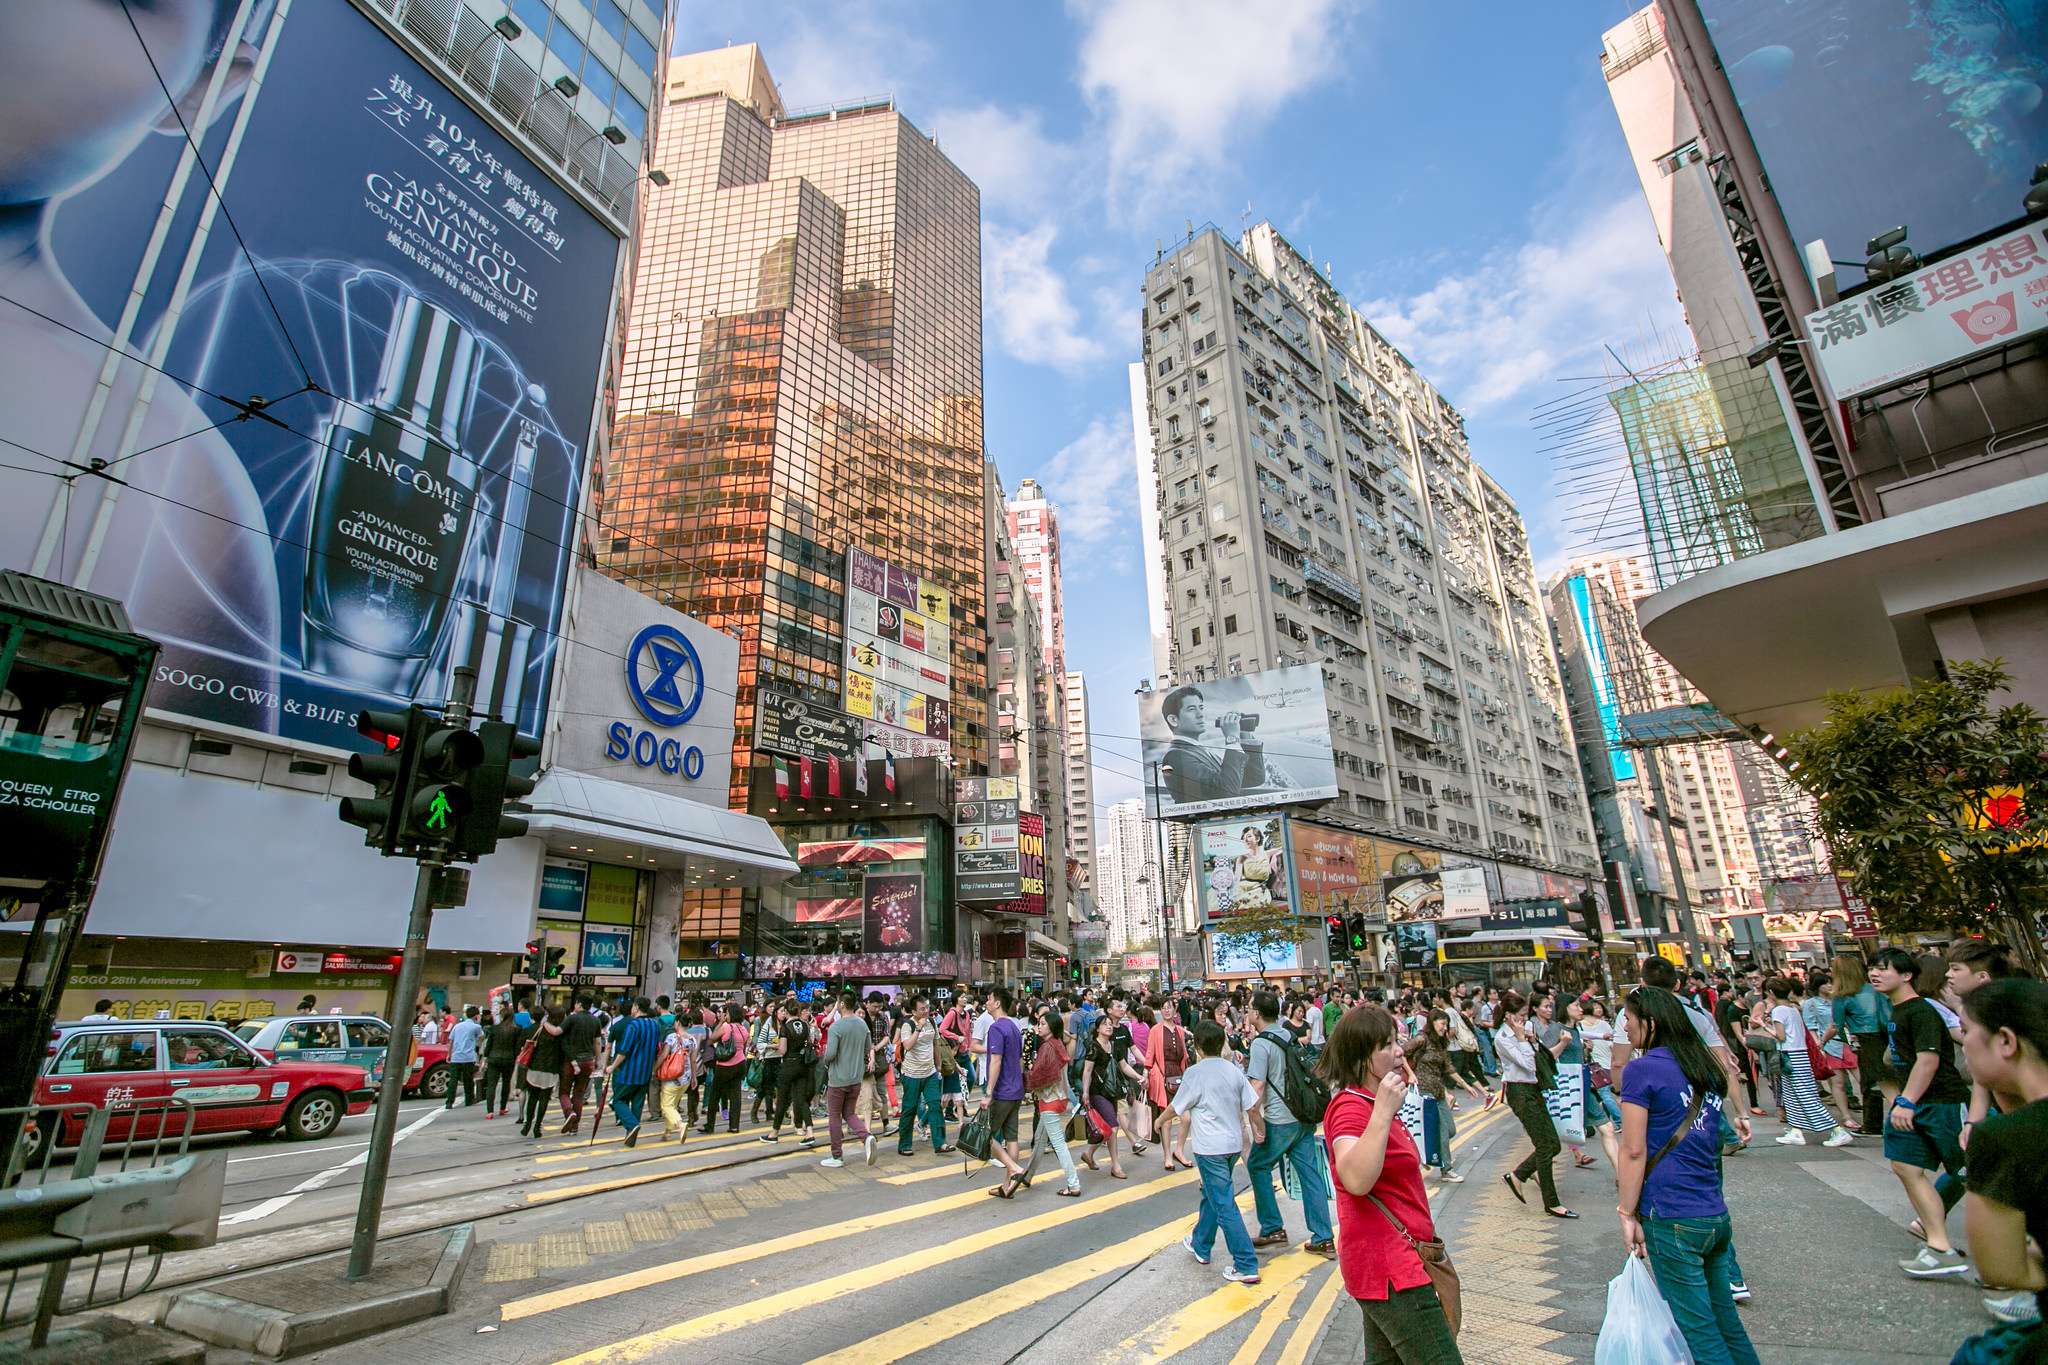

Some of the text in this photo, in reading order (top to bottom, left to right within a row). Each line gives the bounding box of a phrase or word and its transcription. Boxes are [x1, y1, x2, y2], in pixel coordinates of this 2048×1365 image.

[368, 87, 412, 127] 7天
[423, 132, 492, 195] 看得見
[388, 73, 560, 225] 提升10大年輕特質
[364, 198, 534, 323] YOUTH ACTIVATING CONCENTRATE
[342, 439, 464, 513] LANCÔME
[338, 519, 439, 571] GÉNIFIQUE
[346, 546, 424, 583] YOUTH ACTIVATING
[351, 559, 415, 589] CONCENTRATE
[155, 665, 225, 695] SOGO
[230, 685, 279, 709] CWB
[284, 699, 301, 715] &
[306, 703, 345, 728] B1/F
[605, 721, 704, 781] SOGO
[0, 780, 100, 802] QUEEN ETRO
[23, 797, 96, 815] SCHOULER
[872, 885, 917, 907] Surprise!
[69, 975, 202, 987] SOGO 28th Anniversary
[563, 975, 595, 985] SOGO
[106, 1086, 135, 1099] 的士
